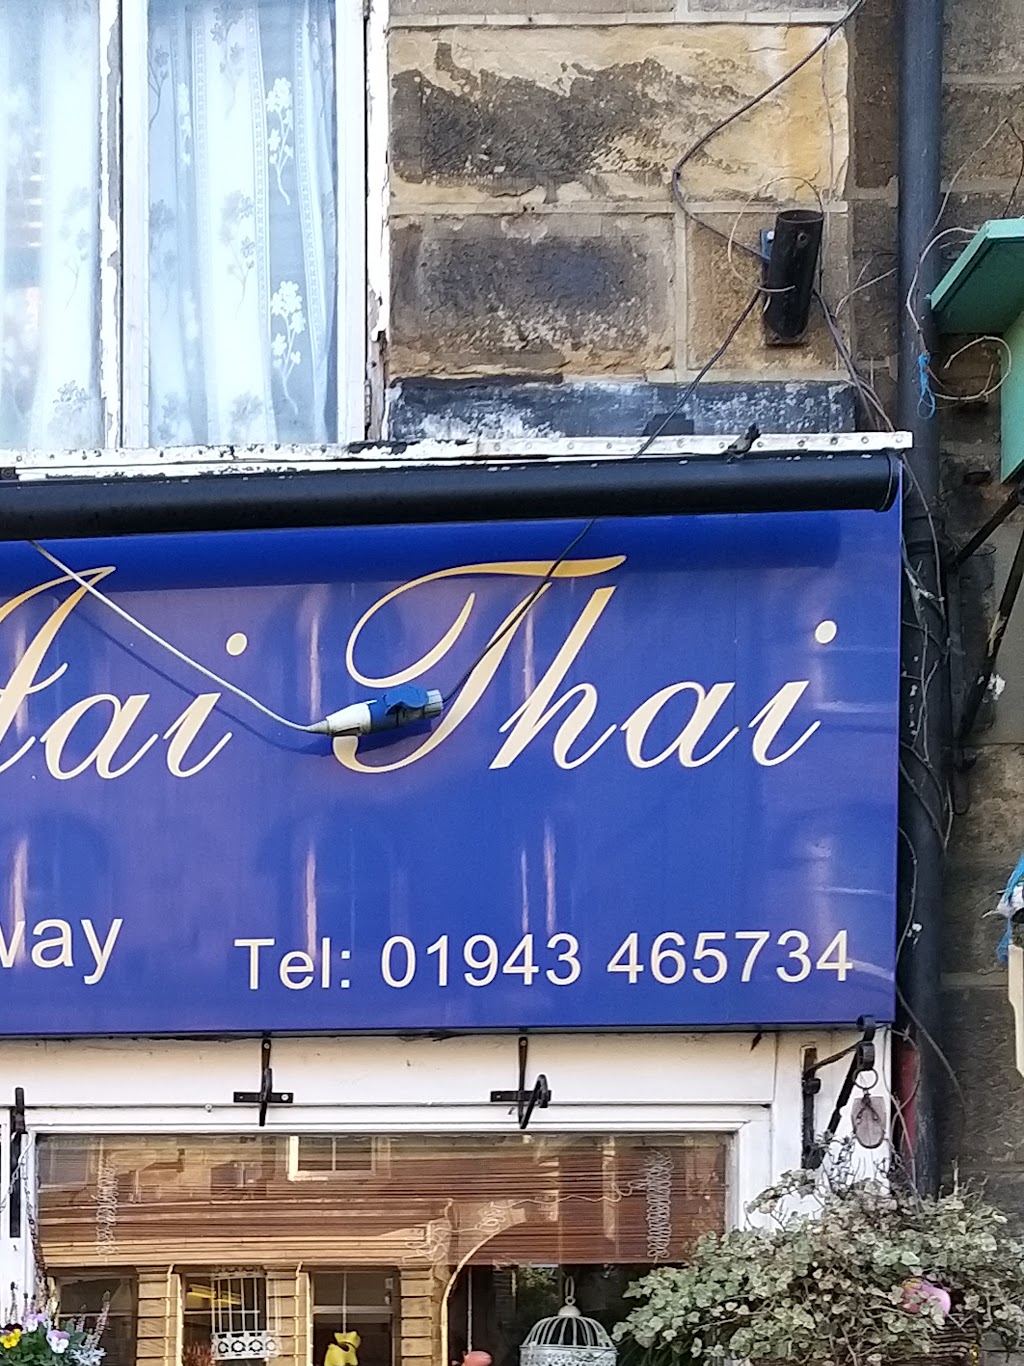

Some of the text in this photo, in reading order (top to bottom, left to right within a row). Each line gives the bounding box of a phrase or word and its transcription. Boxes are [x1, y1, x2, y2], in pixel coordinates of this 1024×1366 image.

[332, 555, 837, 773] Thai
[235, 930, 853, 990] Tel: 01943 465734
